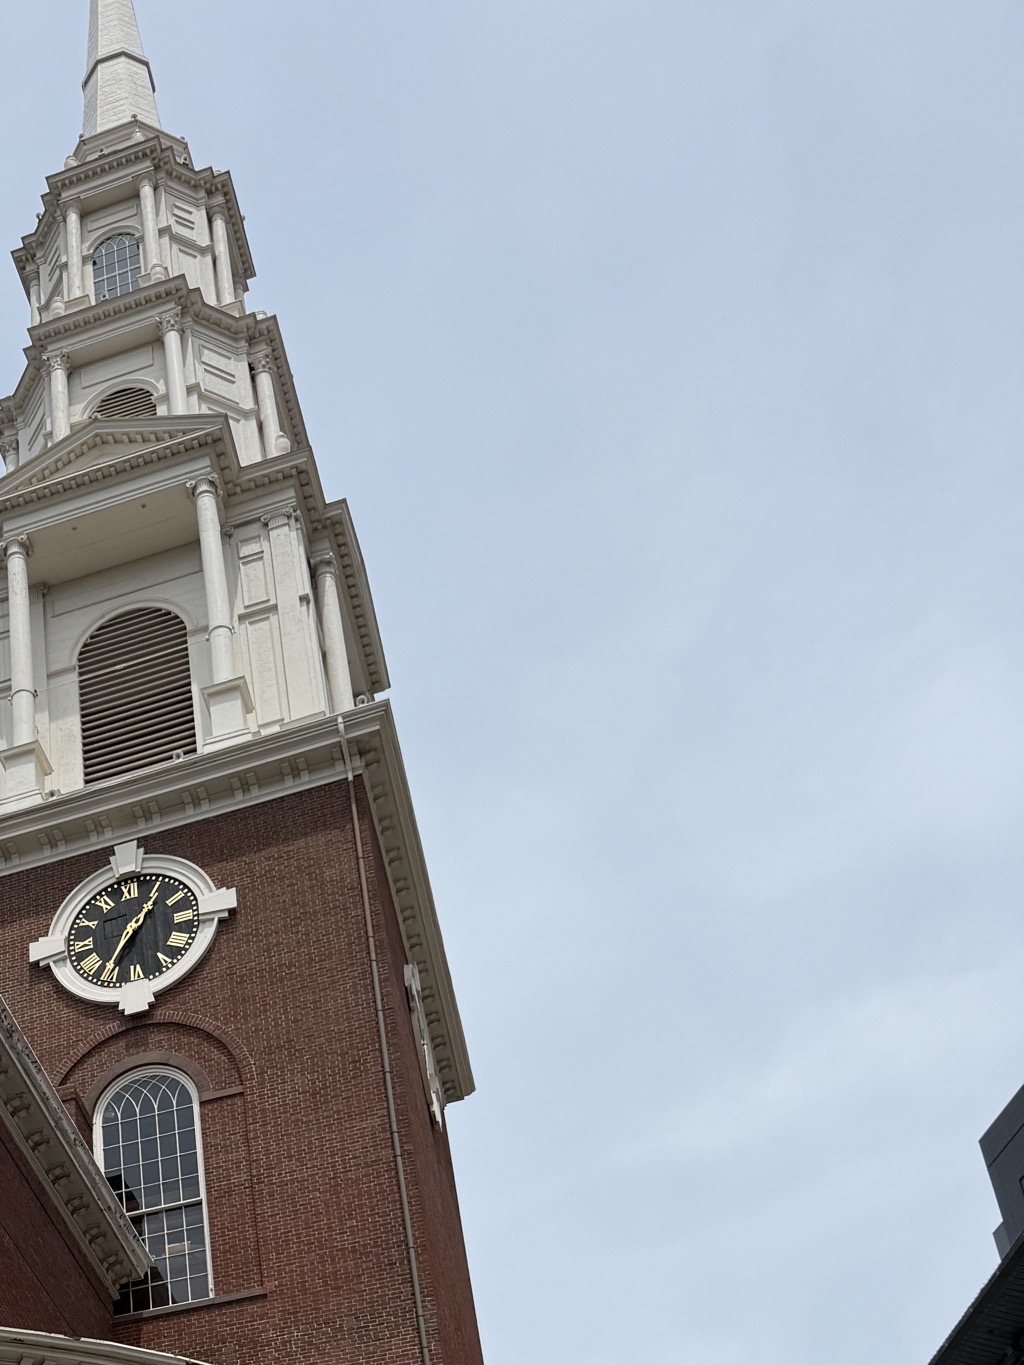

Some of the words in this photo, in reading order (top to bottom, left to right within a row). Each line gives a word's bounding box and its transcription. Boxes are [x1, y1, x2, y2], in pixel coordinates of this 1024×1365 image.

[121, 882, 138, 901] XII
[95, 895, 115, 913] XI
[173, 909, 193, 924] III
